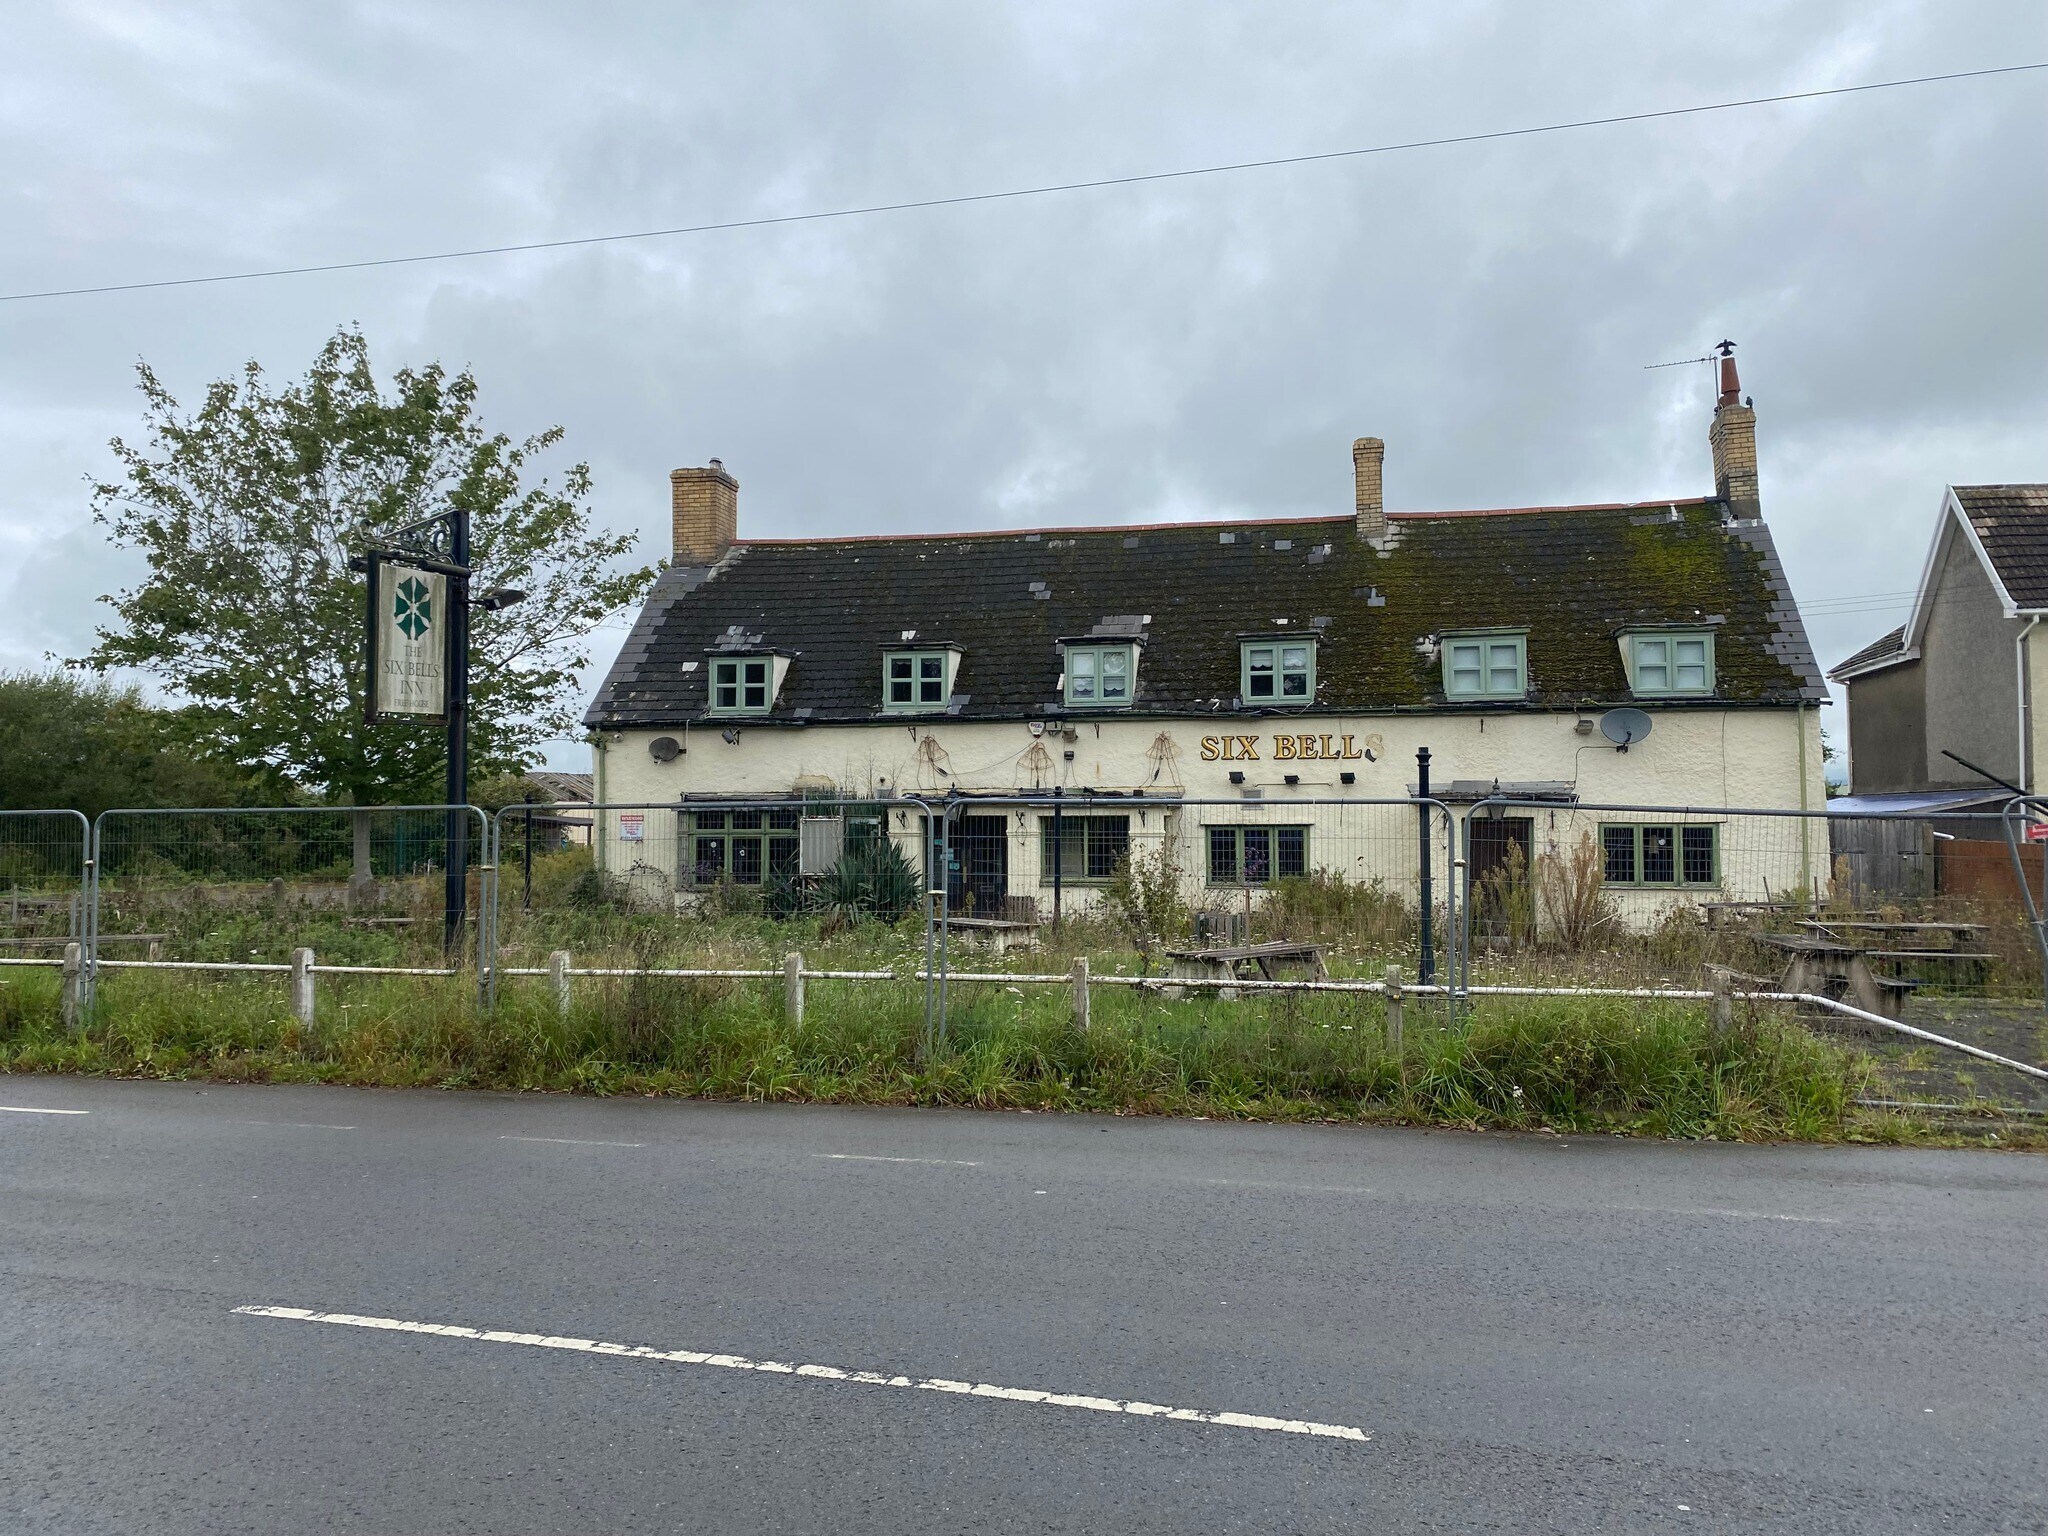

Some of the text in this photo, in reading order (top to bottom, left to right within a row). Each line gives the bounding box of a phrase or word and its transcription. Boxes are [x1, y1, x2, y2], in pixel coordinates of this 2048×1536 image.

[404, 645, 422, 658] THE
[384, 660, 439, 678] SIX BELLS
[400, 680, 424, 695] INN
[1200, 735, 1260, 761] SIX
